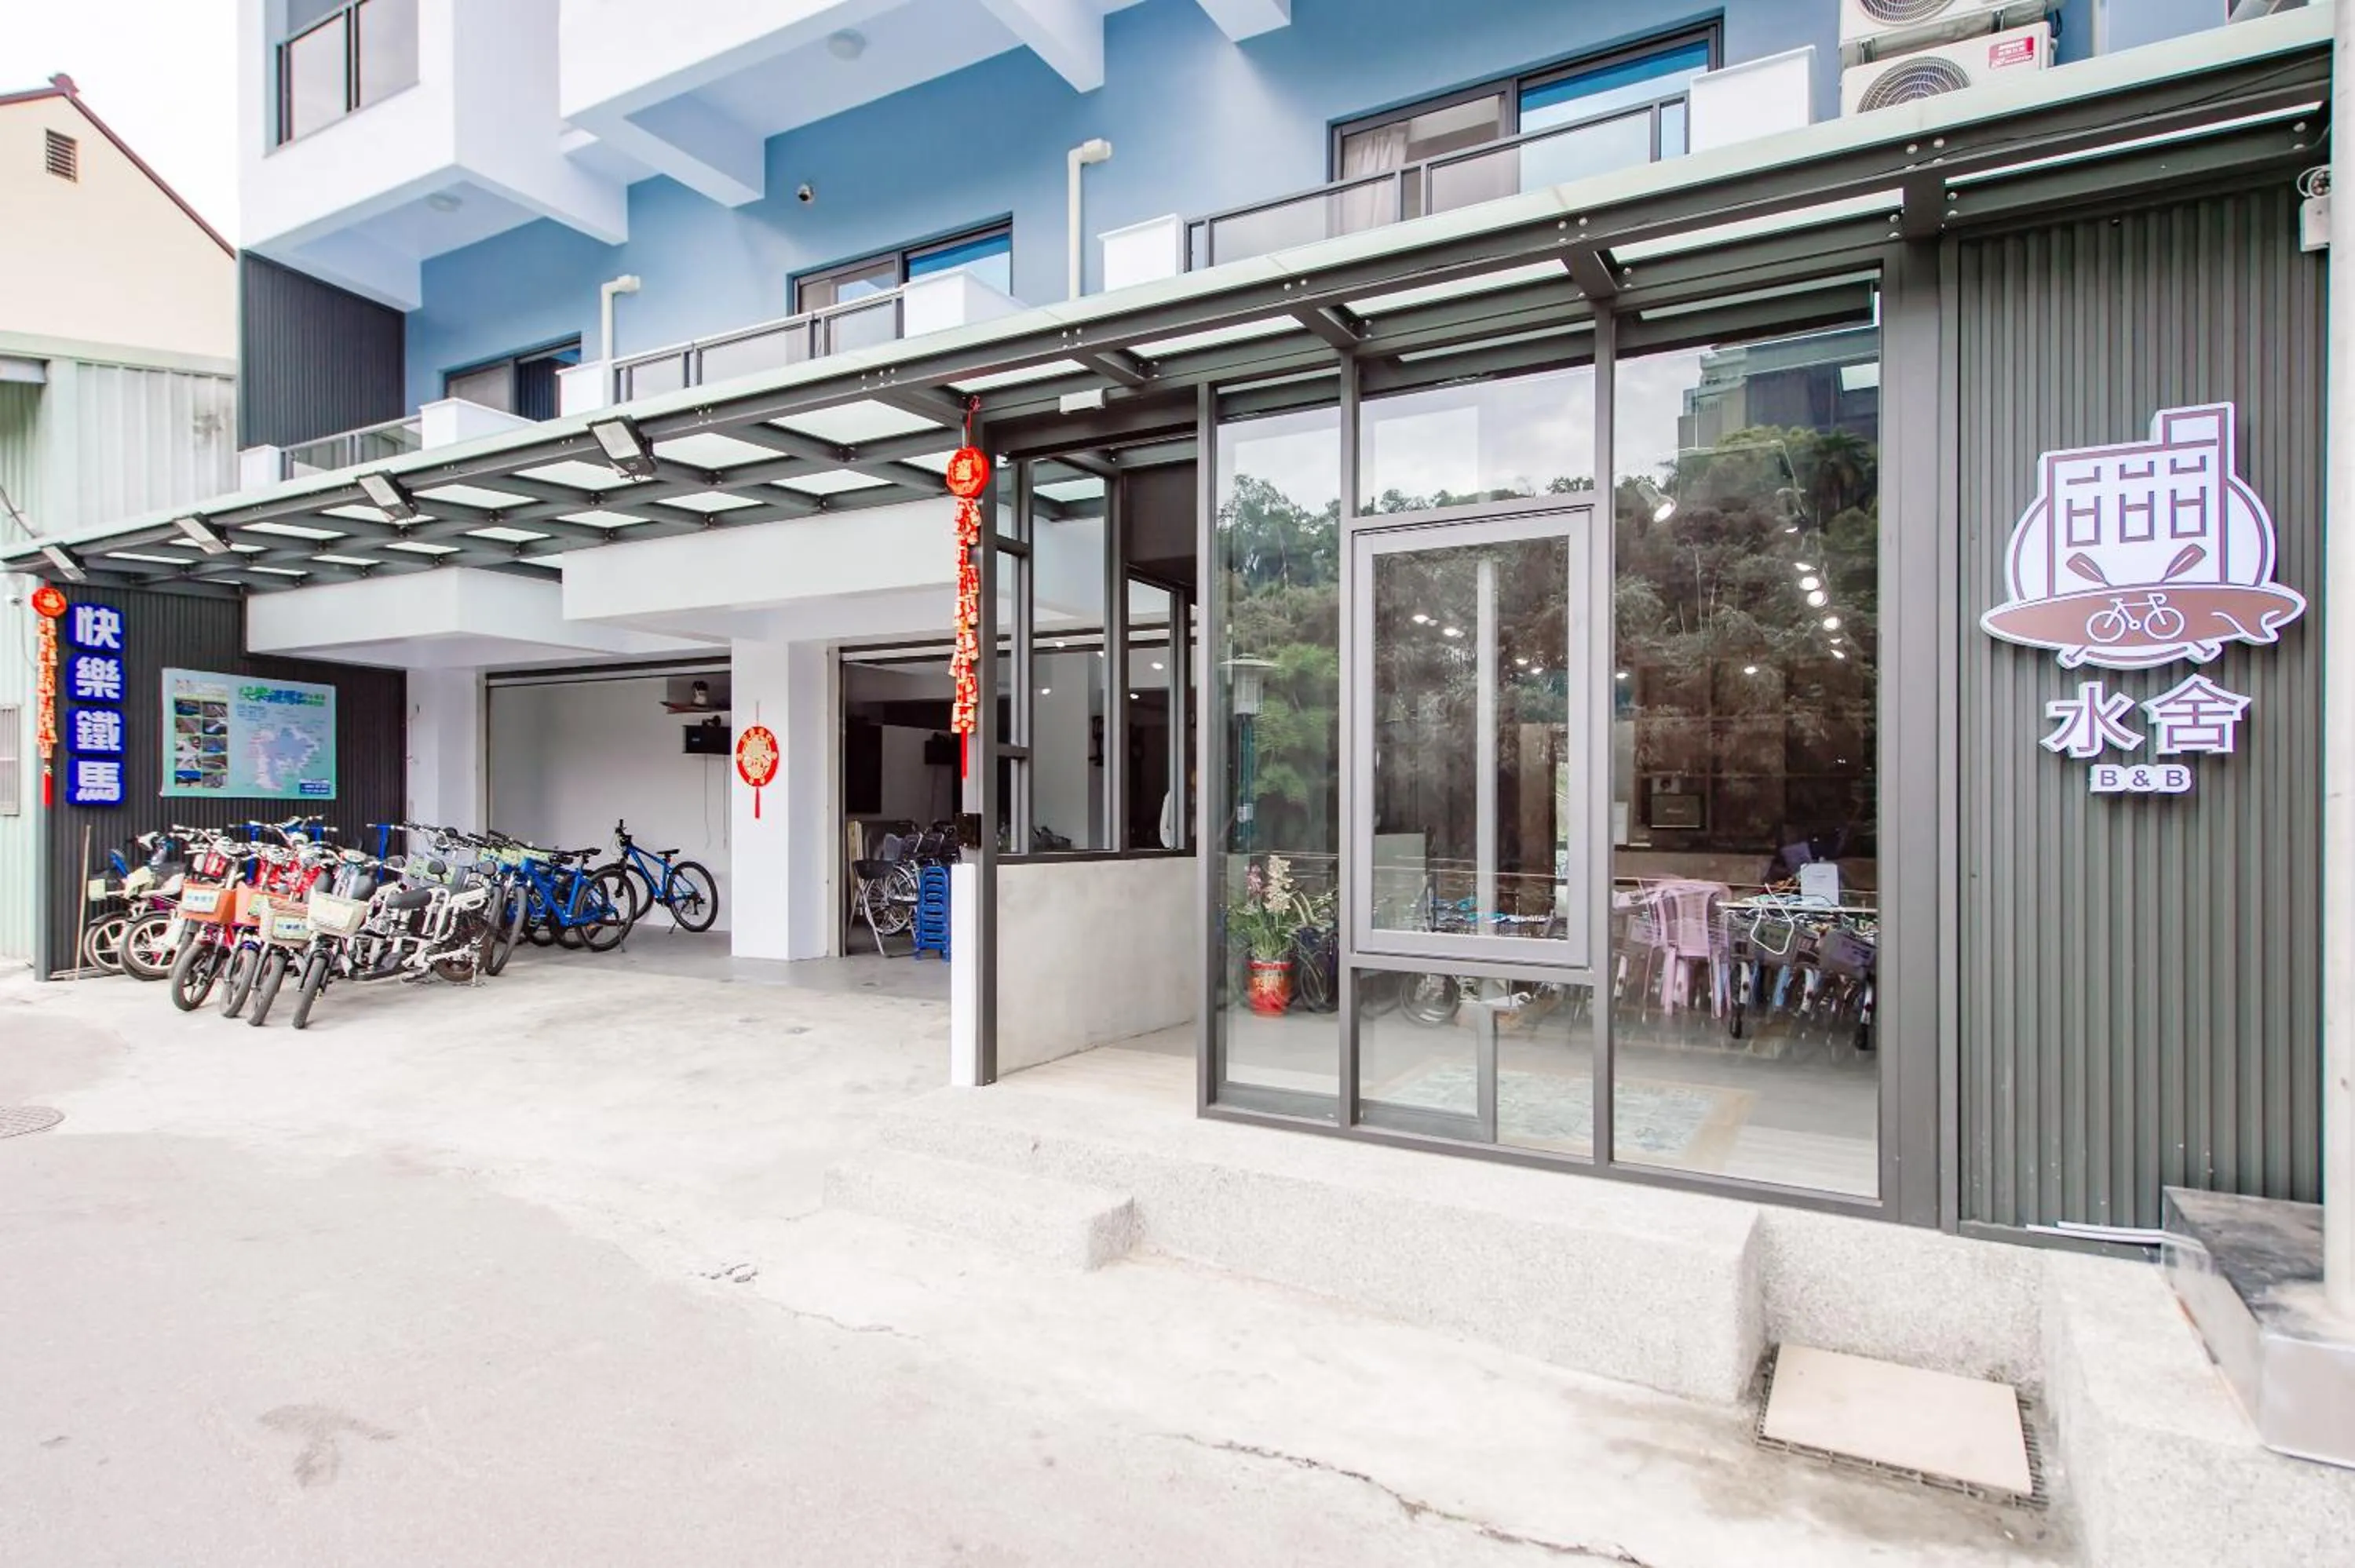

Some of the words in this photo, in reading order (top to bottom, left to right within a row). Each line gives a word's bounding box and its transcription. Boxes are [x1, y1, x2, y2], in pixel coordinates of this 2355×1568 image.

[75, 605, 121, 802] 快樂鐵馬
[2043, 673, 2250, 757] 水舍
[2096, 768, 2188, 789] B&B
